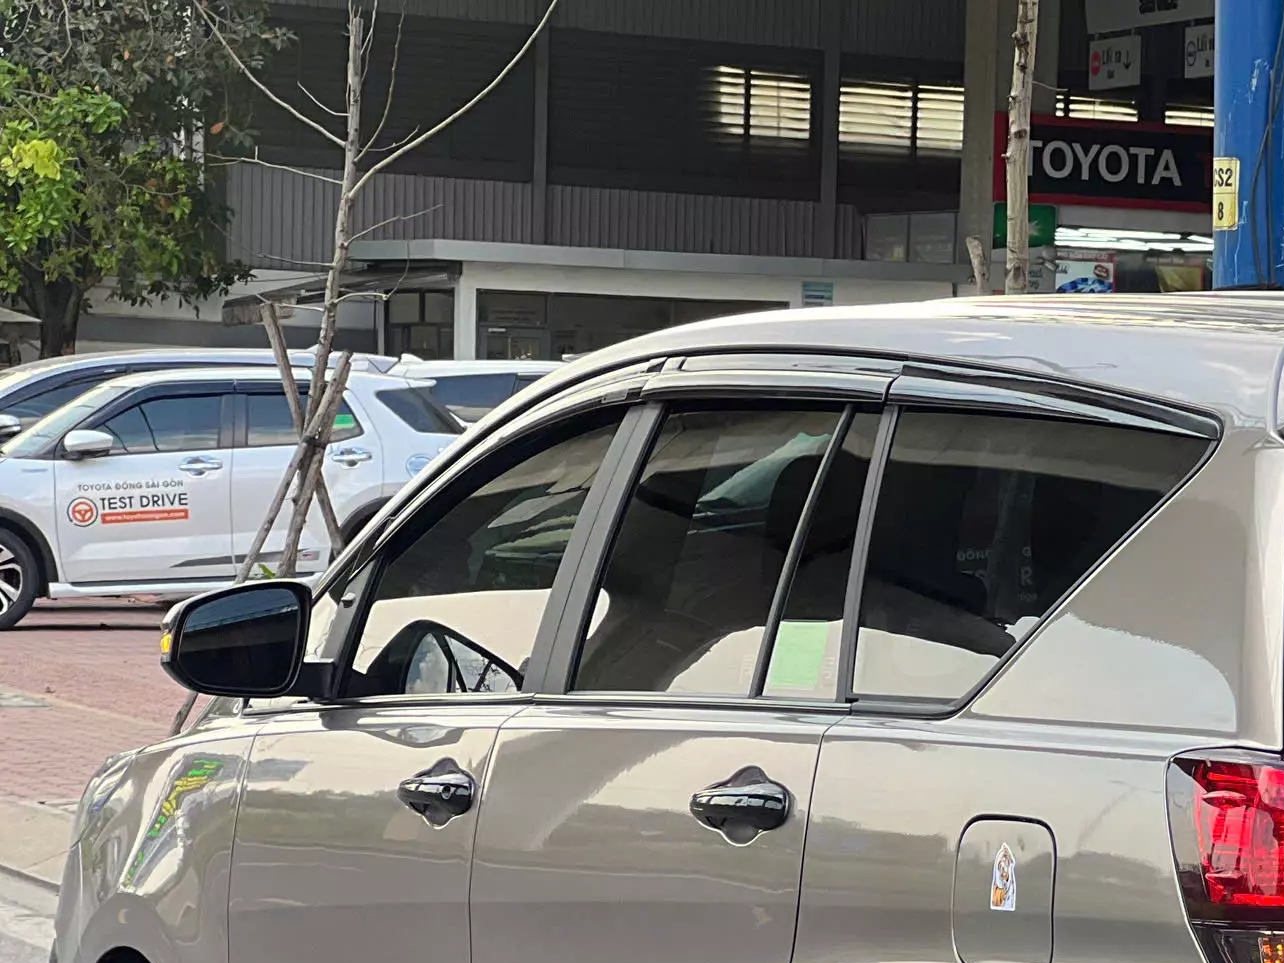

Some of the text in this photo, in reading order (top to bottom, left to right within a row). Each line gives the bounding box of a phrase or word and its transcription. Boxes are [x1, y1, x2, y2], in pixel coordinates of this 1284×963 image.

[1028, 140, 1182, 187] TOYOTA
[1217, 201, 1224, 221] 8
[78, 484, 112, 492] TOYOTA
[100, 493, 188, 510] TEST DRIVE
